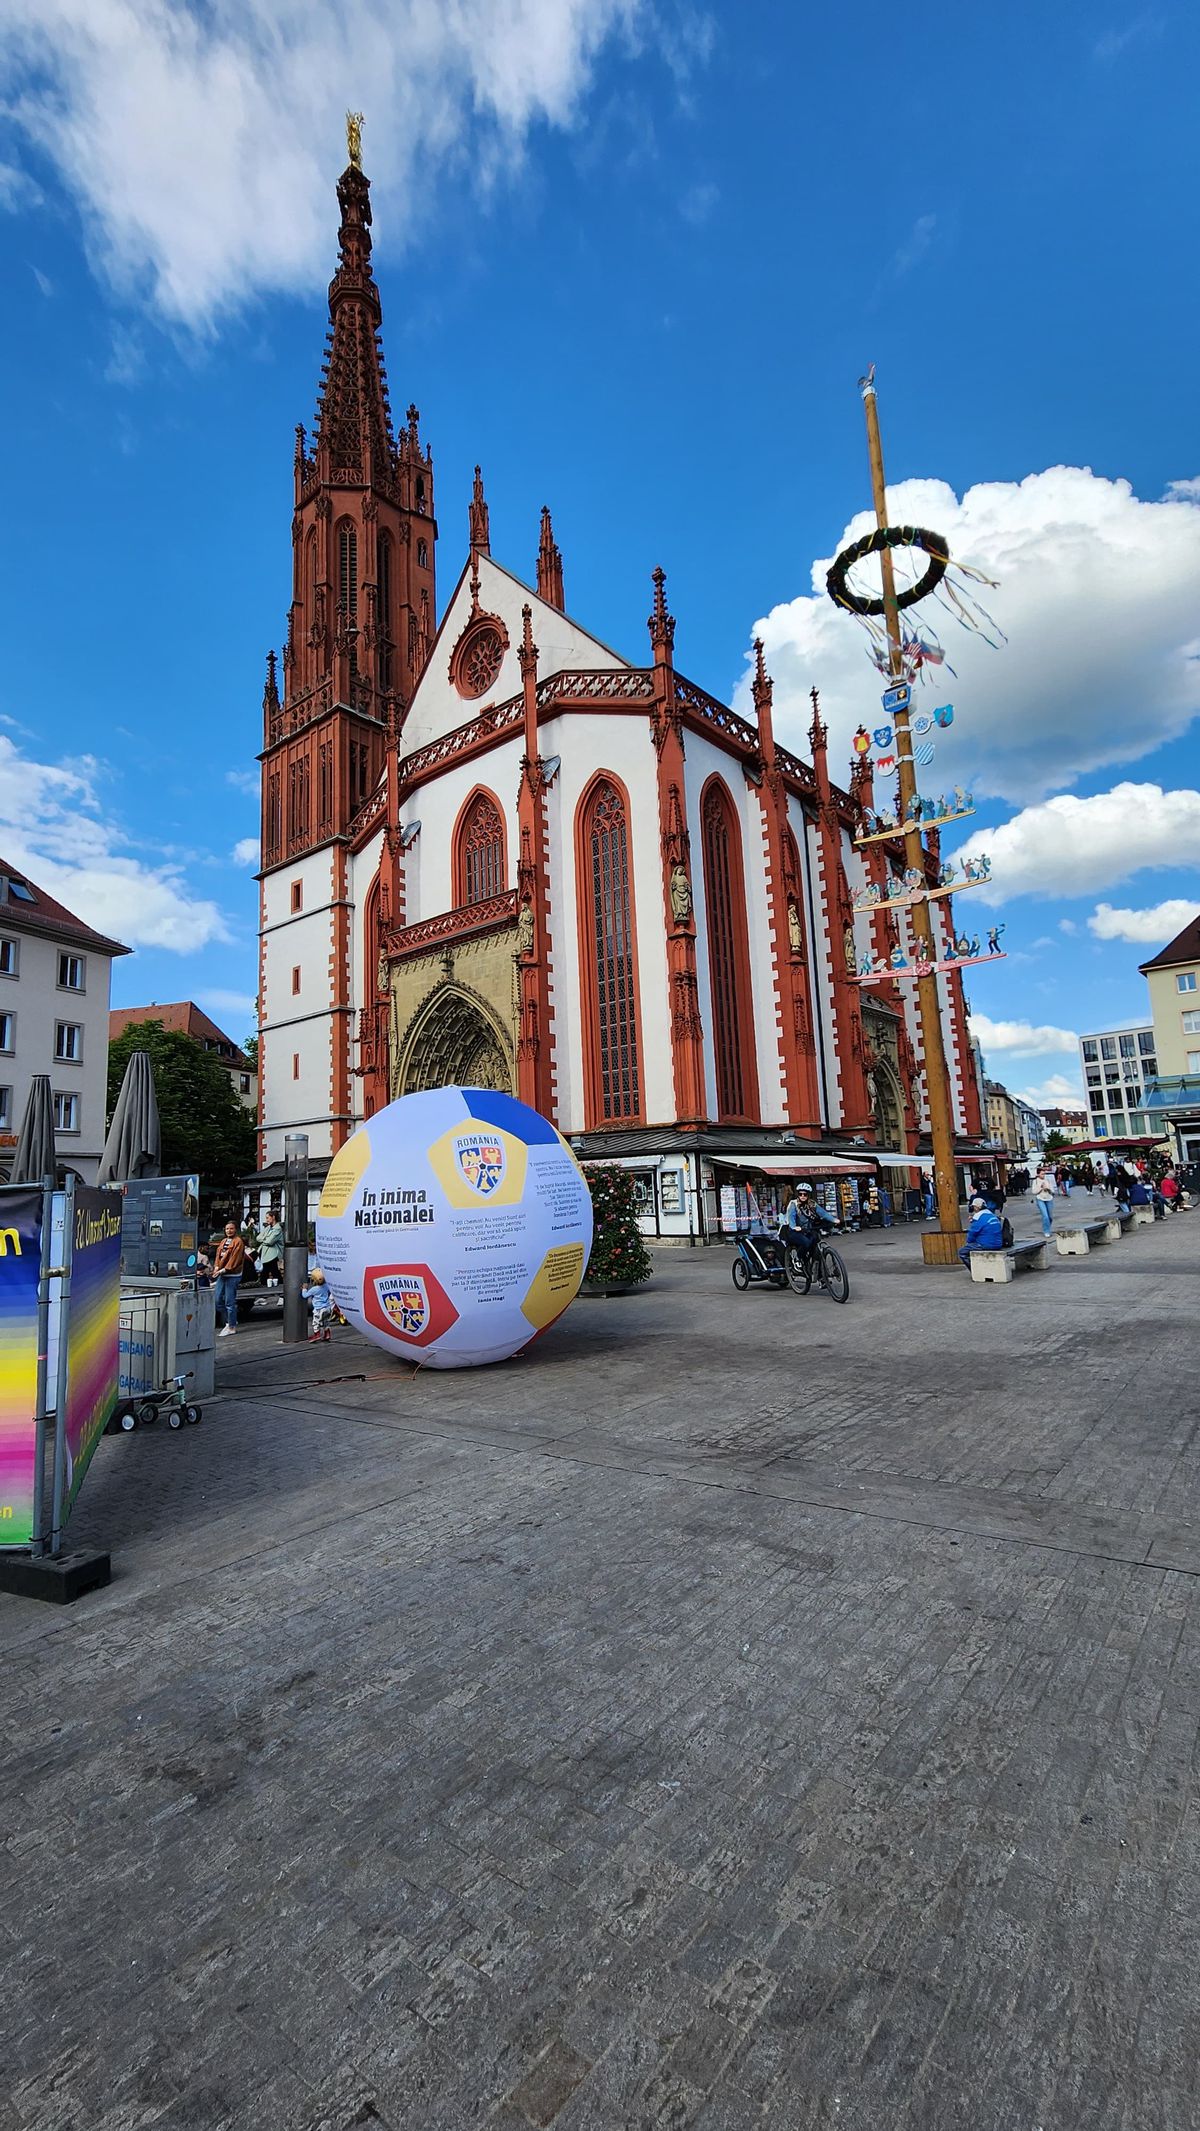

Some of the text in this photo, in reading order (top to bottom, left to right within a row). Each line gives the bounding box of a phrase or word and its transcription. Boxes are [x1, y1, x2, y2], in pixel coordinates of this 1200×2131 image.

[457, 1135, 500, 1148] ROMÂNIA
[362, 1187, 377, 1207] În
[380, 1186, 426, 1205] inima
[379, 1277, 420, 1291] ROMÂNIA
[118, 1341, 153, 1358] EINGANG
